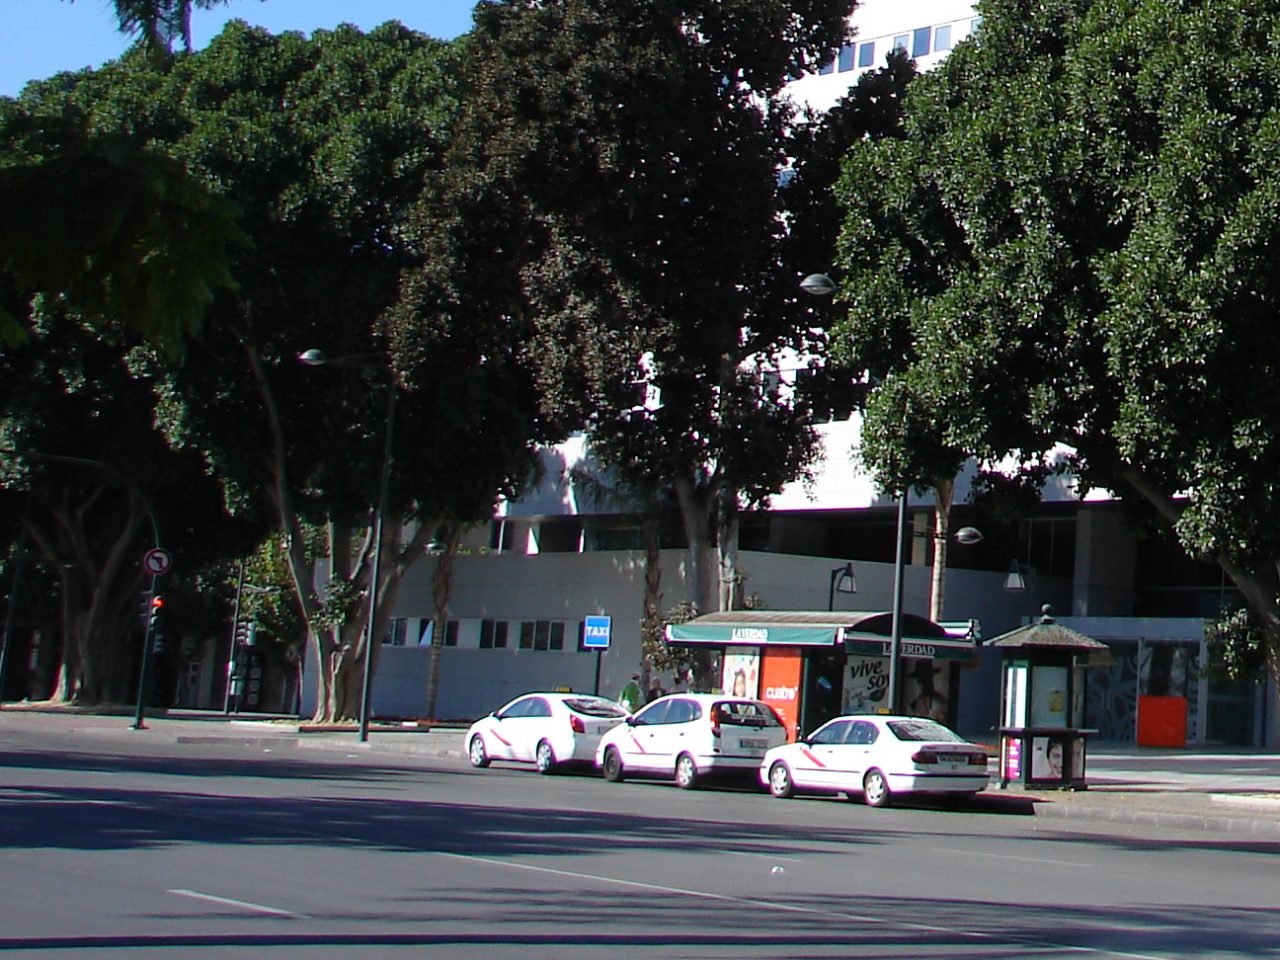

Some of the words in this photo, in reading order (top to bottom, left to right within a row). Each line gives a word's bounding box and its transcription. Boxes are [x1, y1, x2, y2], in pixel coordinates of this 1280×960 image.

[586, 626, 609, 636] TAXI
[901, 643, 936, 656] ERDAD
[851, 660, 883, 679] vive
